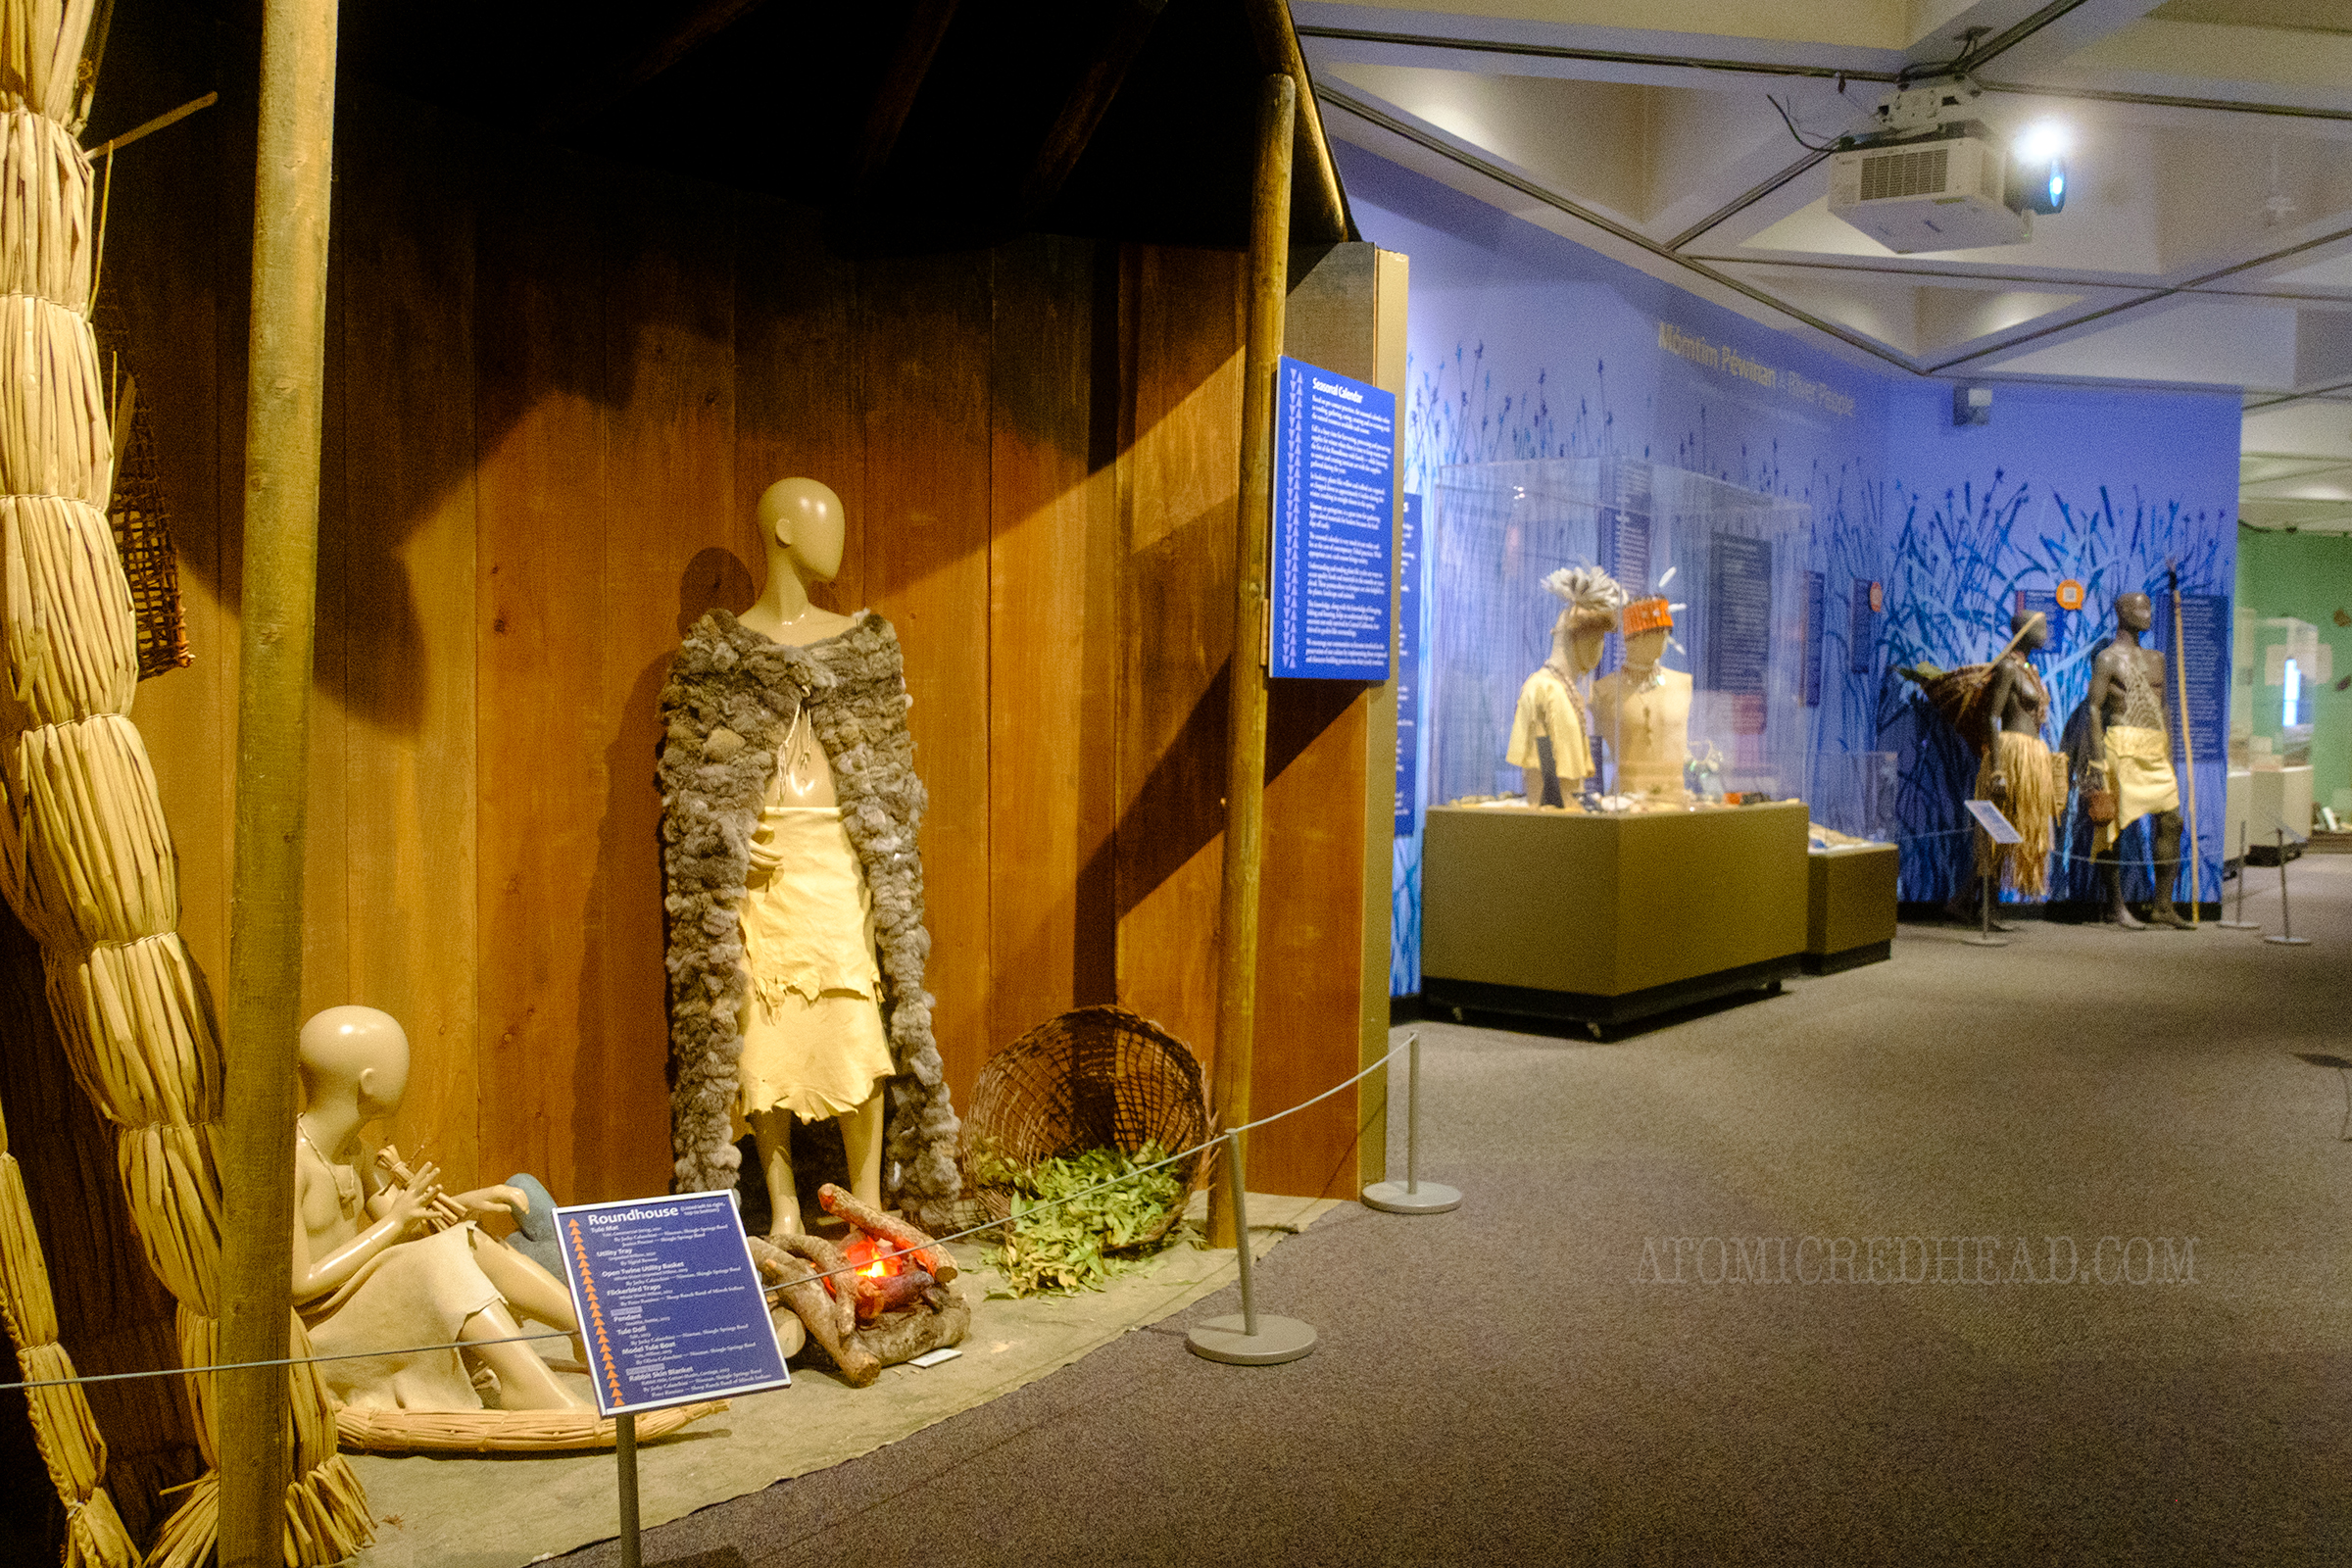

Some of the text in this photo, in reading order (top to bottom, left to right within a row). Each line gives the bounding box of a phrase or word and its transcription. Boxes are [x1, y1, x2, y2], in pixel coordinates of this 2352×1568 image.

[1312, 377, 1363, 403] Seasonal Calendar
[1817, 381, 1855, 417] People
[586, 1204, 679, 1225] Roundhouse
[620, 1266, 641, 1275] Twine
[606, 1286, 642, 1296] Flickerbird
[612, 1313, 641, 1322] Pendant
[620, 1346, 644, 1354] Model
[627, 1372, 651, 1381] Rabbit
[667, 1366, 694, 1375] Blanket
